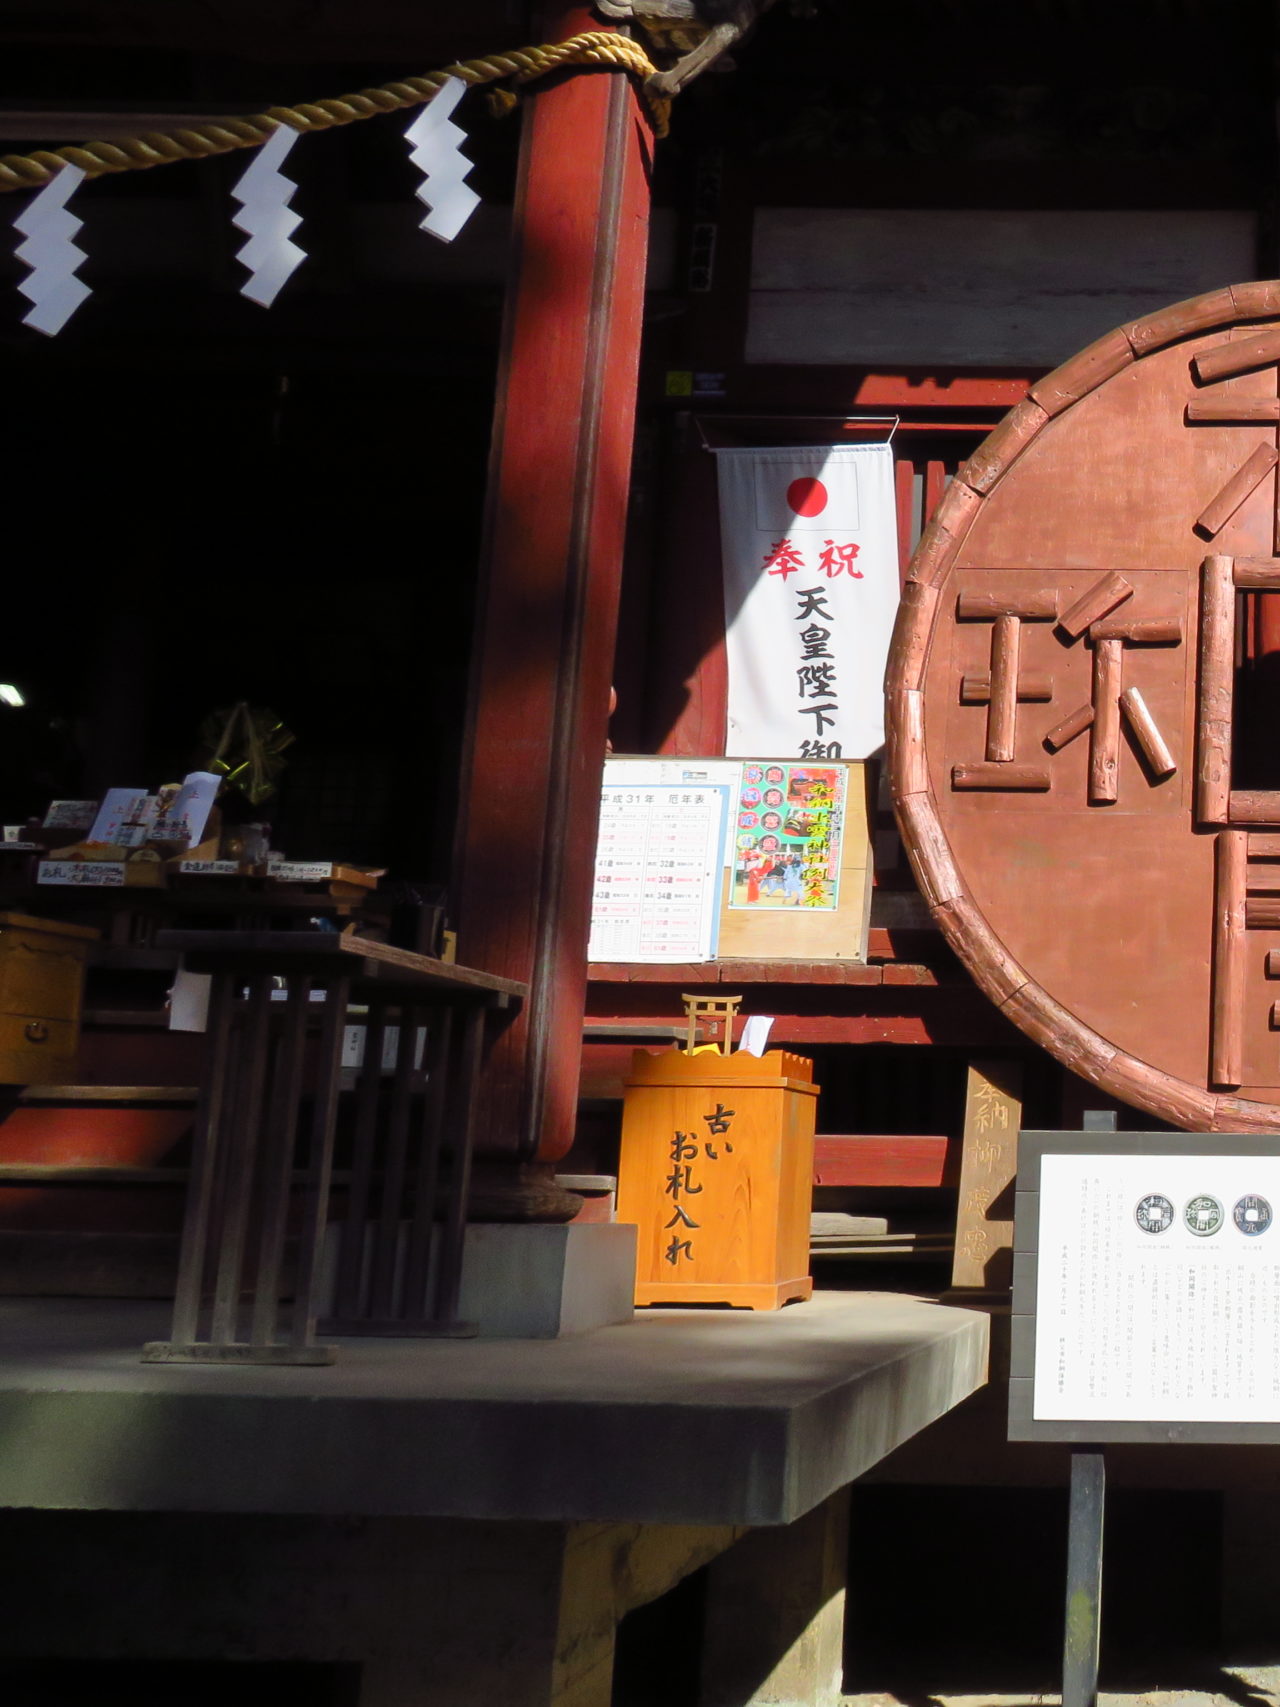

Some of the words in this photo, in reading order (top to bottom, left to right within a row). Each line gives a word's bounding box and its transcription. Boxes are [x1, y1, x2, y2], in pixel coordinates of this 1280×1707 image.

[762, 539, 864, 582] 奉祝
[703, 1103, 736, 1161] 古い
[664, 1130, 702, 1266] お札入れ
